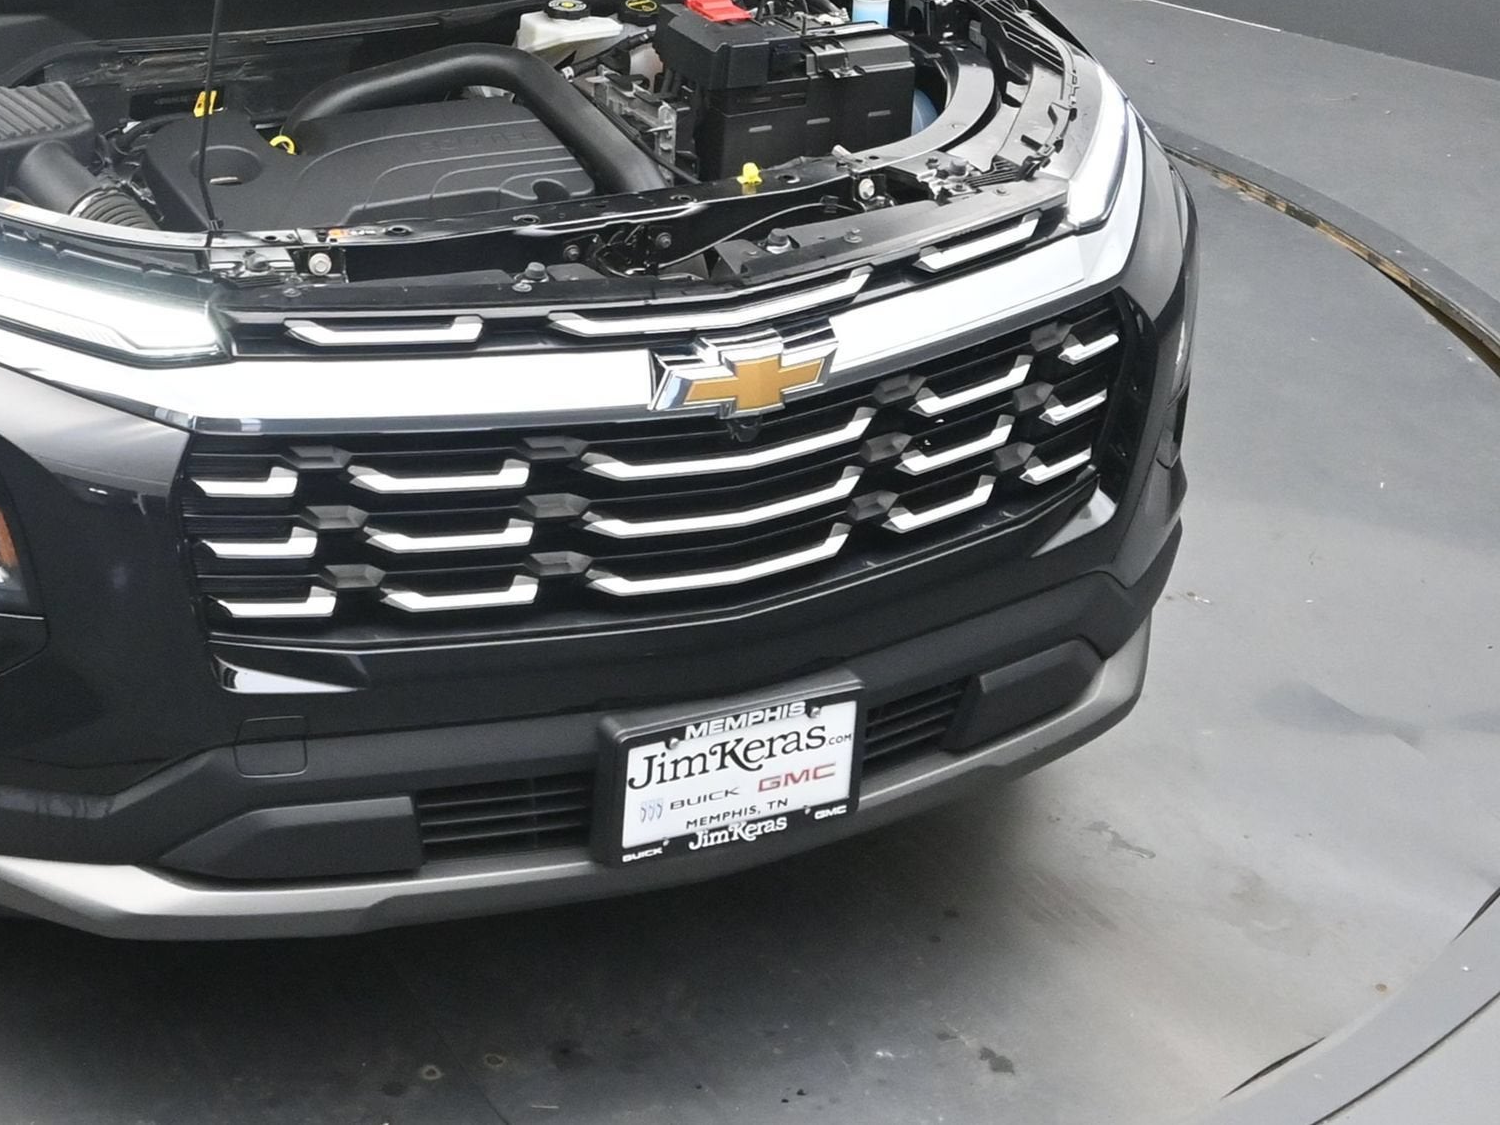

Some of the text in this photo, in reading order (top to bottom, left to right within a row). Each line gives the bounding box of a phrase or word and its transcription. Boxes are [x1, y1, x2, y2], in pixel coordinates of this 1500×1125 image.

[685, 701, 805, 741] MEMPHIS
[670, 762, 837, 810] BUICK GMC
[622, 847, 662, 862] BUICK
[814, 805, 847, 820] GMC
[686, 798, 788, 829] MEMPHIS, TN
